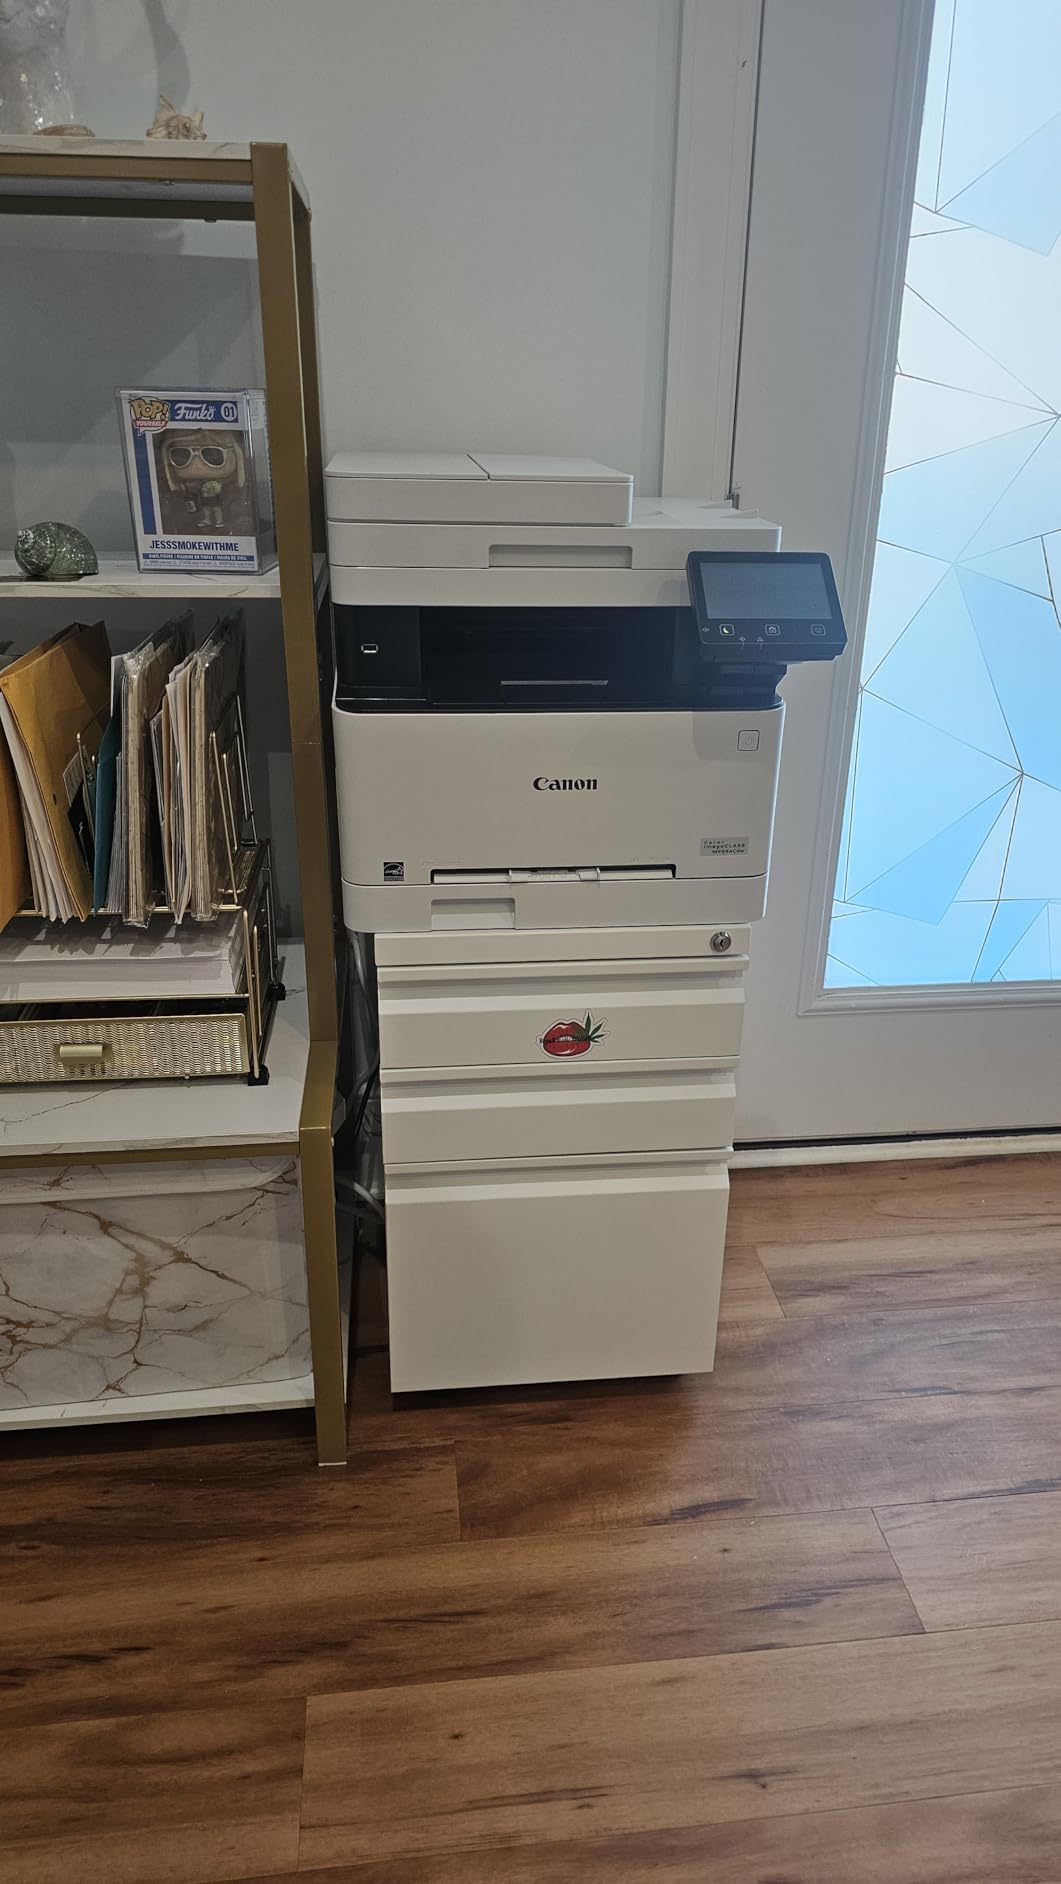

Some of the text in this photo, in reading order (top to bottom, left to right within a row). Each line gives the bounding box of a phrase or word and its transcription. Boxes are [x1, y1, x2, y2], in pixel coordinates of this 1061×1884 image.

[128, 397, 169, 420] POP!
[174, 402, 216, 420] Funko
[149, 540, 239, 552] JESSSMOKEWITHME
[533, 777, 598, 791] Canon
